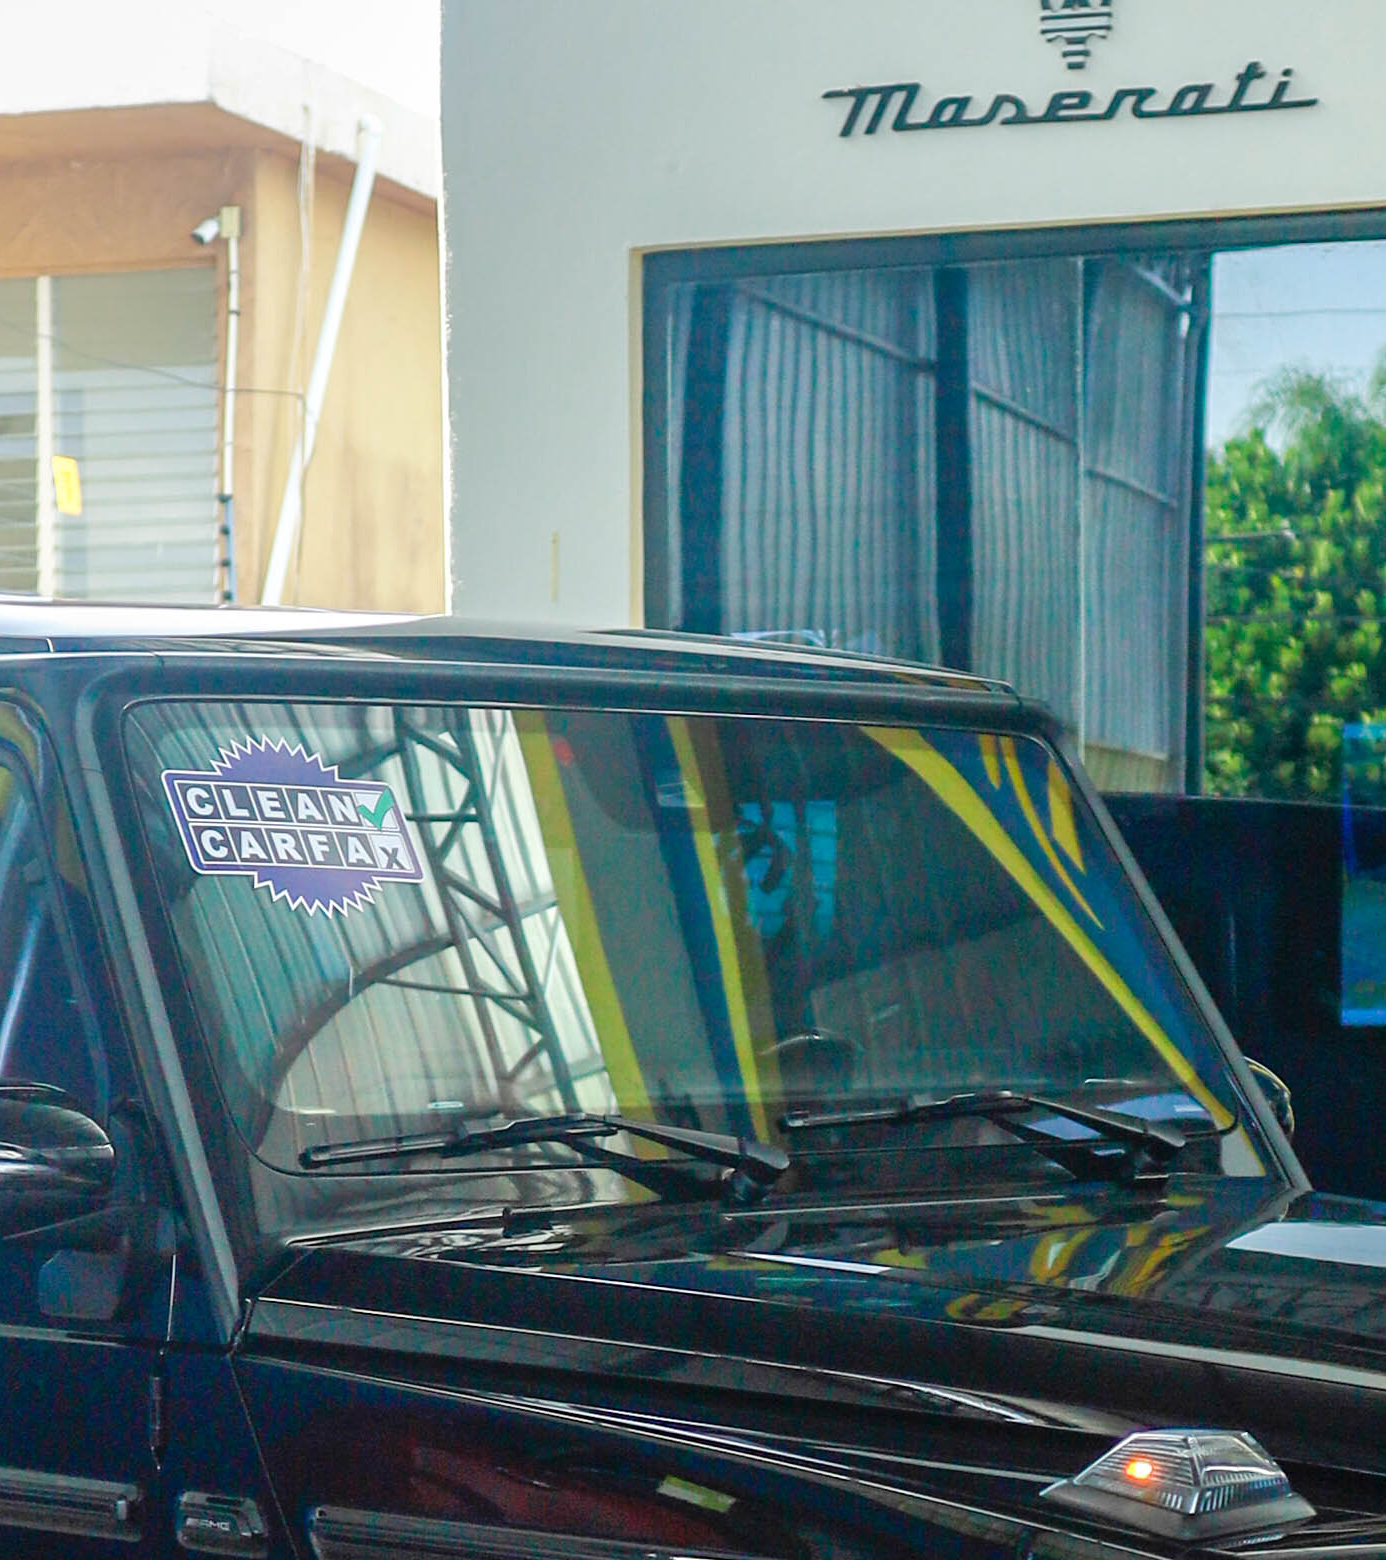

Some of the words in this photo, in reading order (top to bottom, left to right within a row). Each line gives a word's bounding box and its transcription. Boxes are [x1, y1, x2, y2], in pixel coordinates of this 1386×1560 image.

[821, 61, 1319, 137] Maserati
[186, 787, 359, 824] CLEAN
[201, 828, 406, 871] CARFAX
